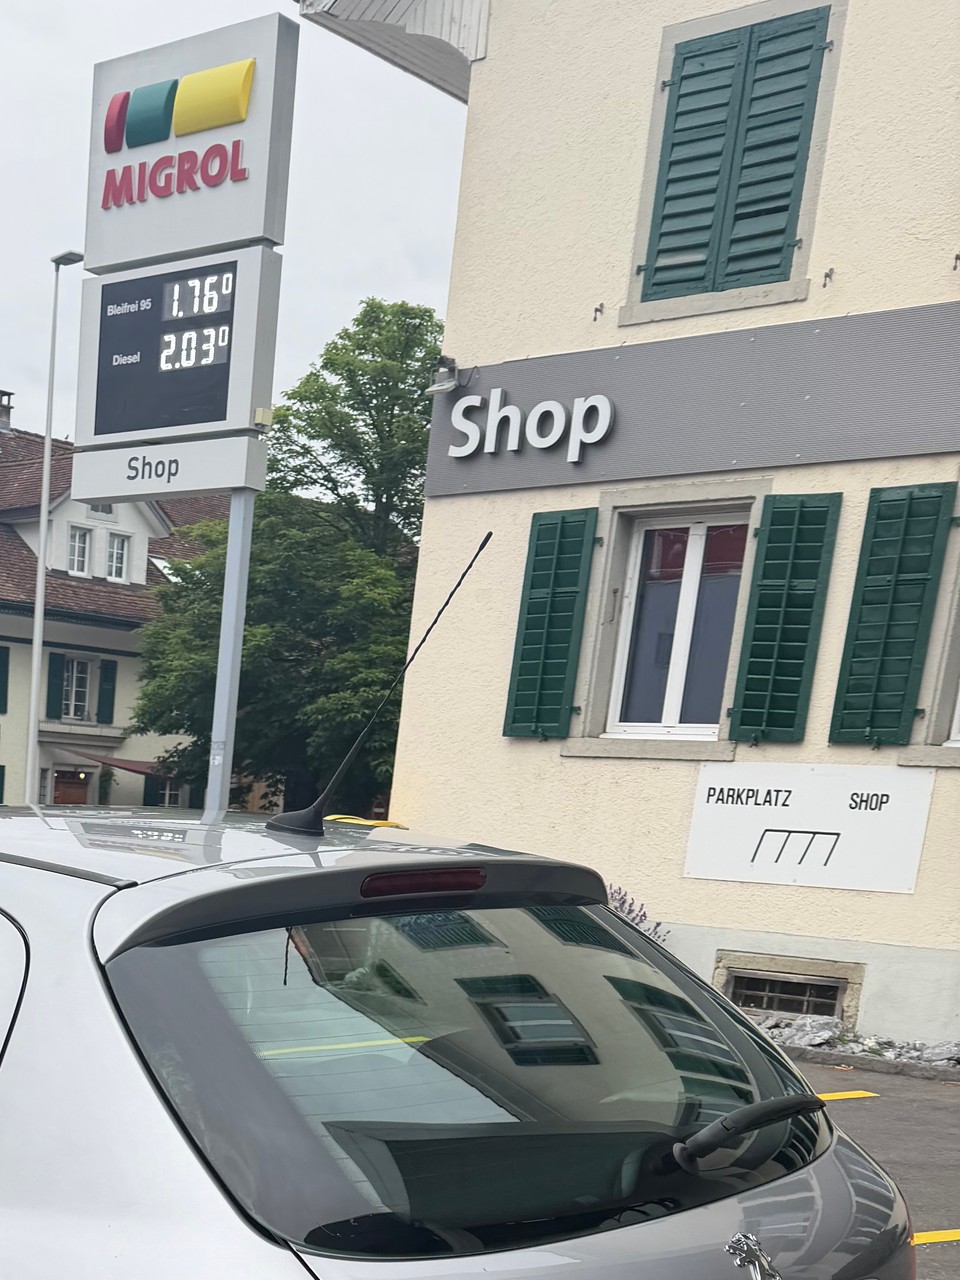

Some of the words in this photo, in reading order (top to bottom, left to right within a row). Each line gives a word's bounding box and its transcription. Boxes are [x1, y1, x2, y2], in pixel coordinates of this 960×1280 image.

[101, 139, 249, 210] MIGROL
[107, 300, 139, 316] Bleifrei
[140, 298, 152, 310] 95
[112, 351, 141, 366] Diesel
[447, 387, 612, 463] Shop
[126, 455, 179, 484] Shop
[706, 786, 792, 807] PARKPLATZ
[848, 792, 890, 811] SHOP
